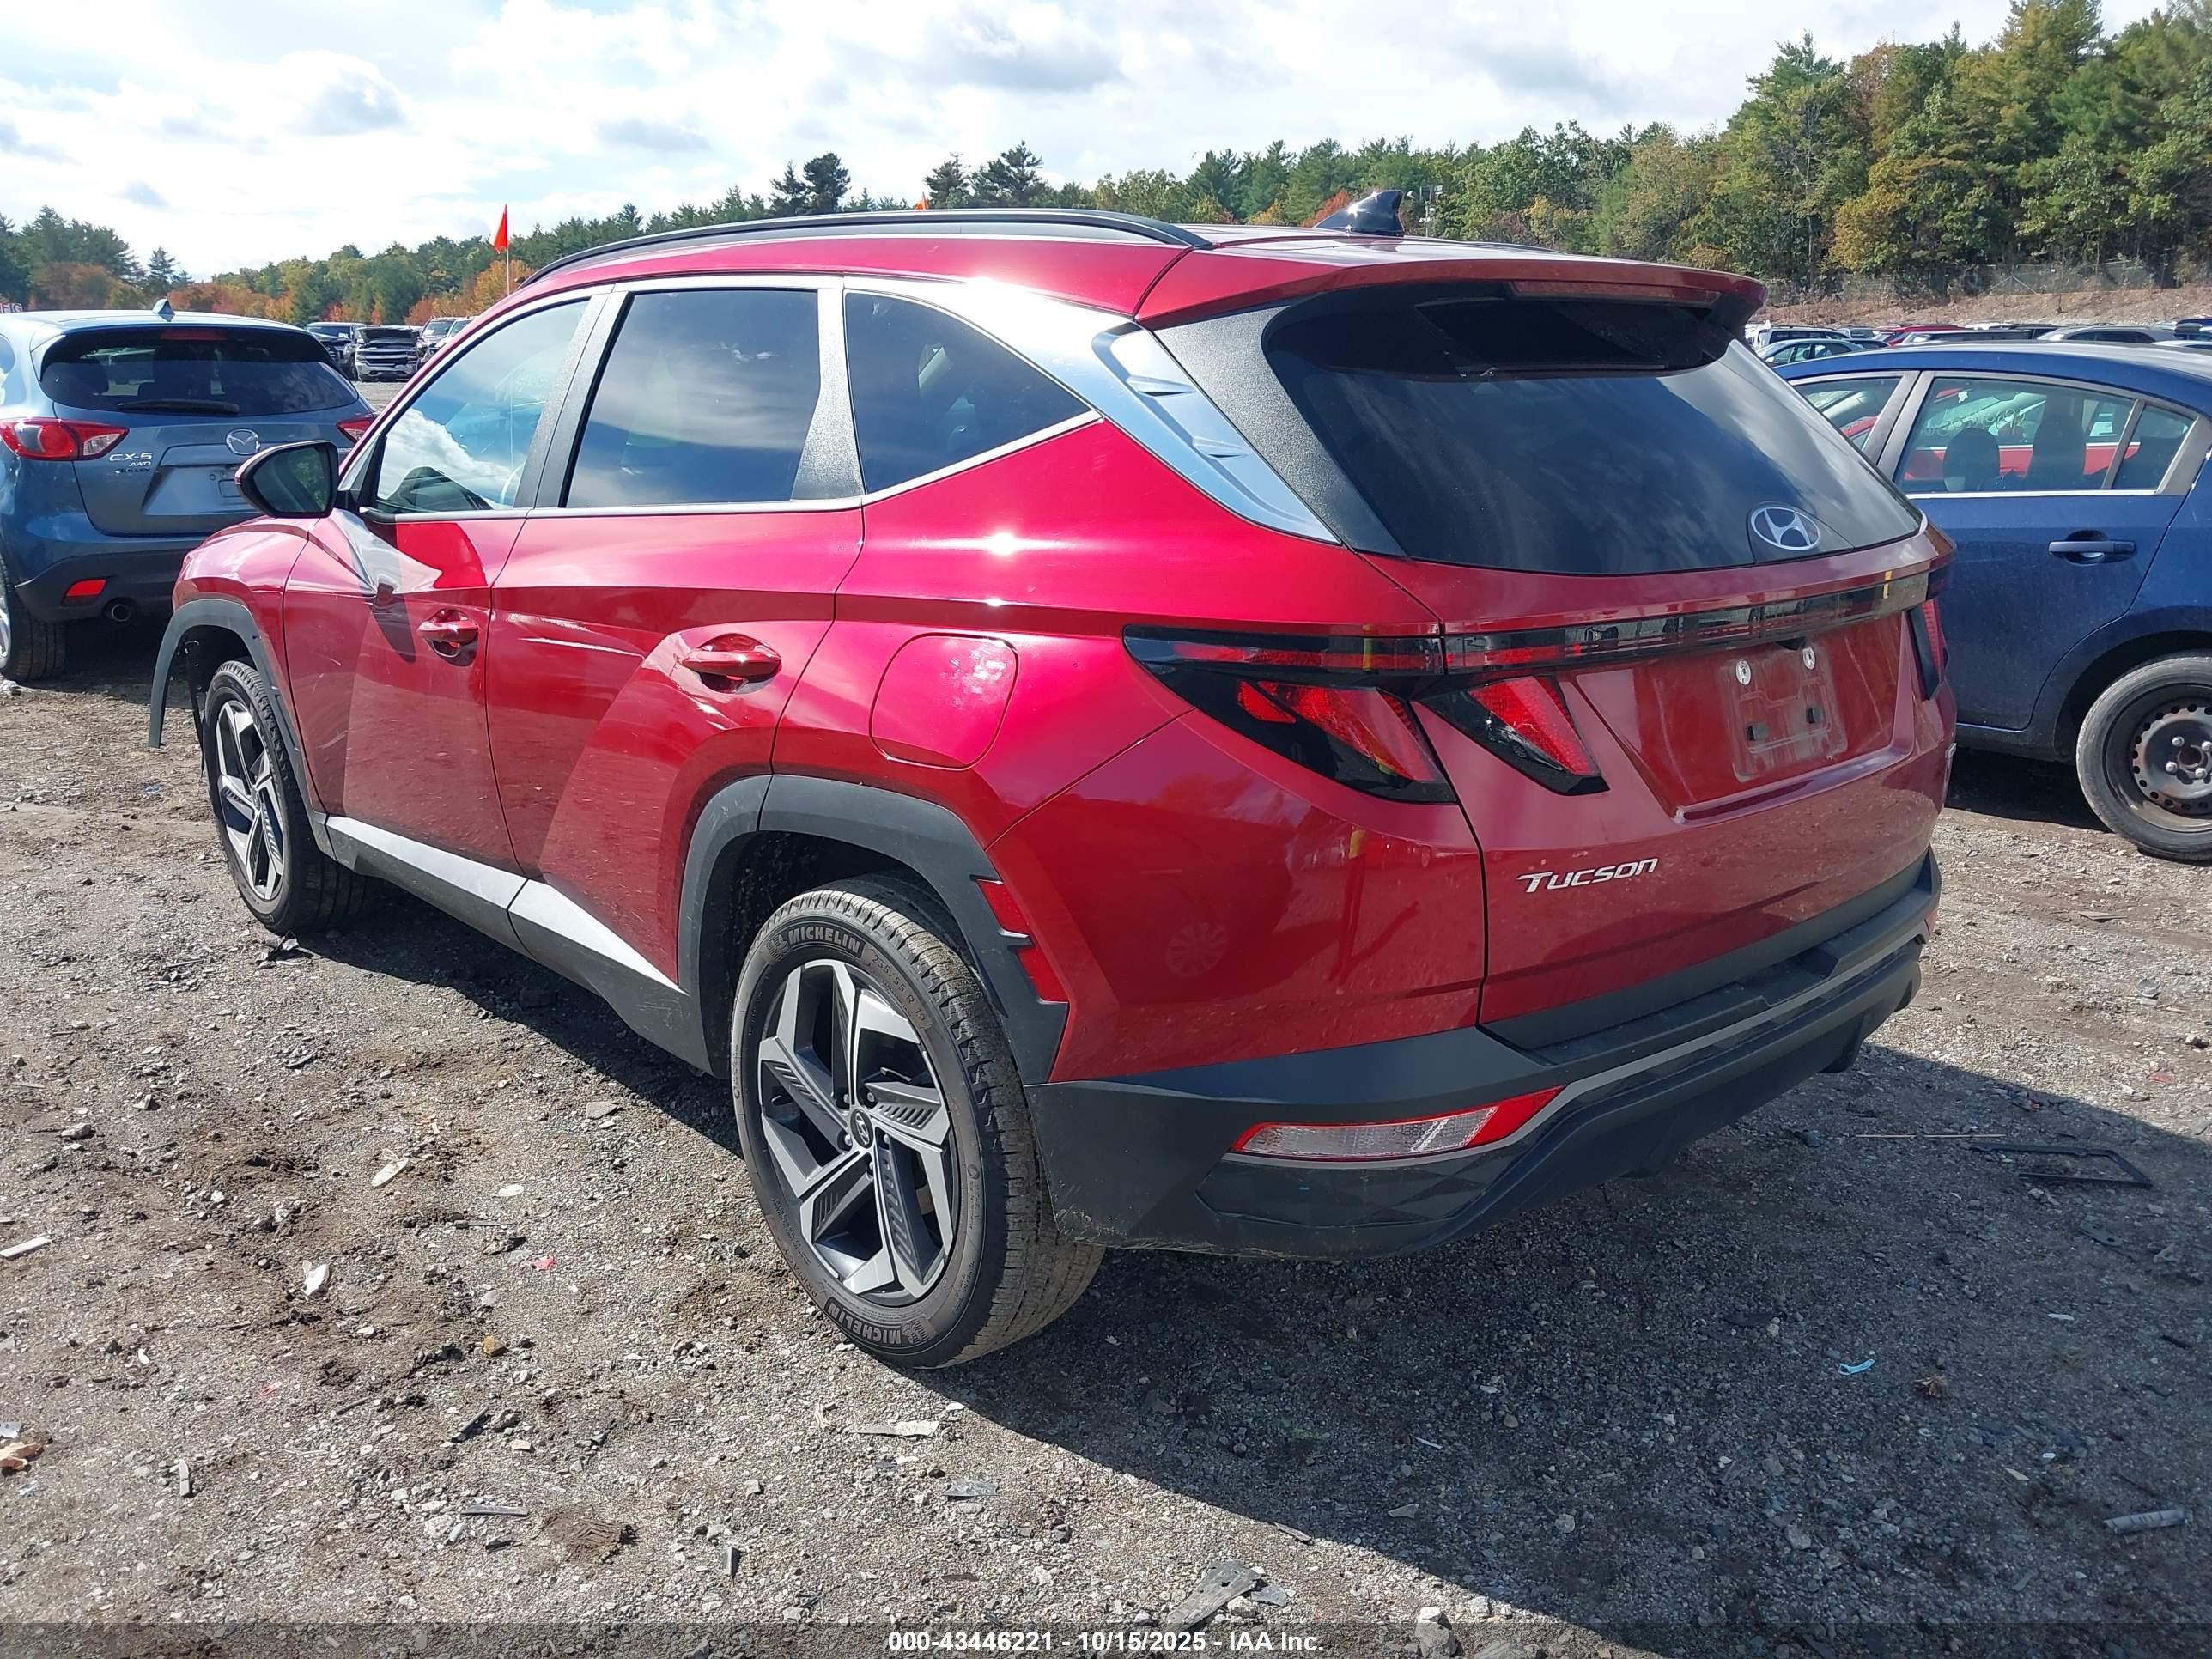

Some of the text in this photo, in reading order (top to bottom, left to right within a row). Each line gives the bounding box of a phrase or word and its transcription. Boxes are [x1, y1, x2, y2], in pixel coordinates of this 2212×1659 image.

[109, 452, 153, 461] CX-5
[788, 926, 861, 954] MICHELIN
[827, 1302, 902, 1345] MICHELIN
